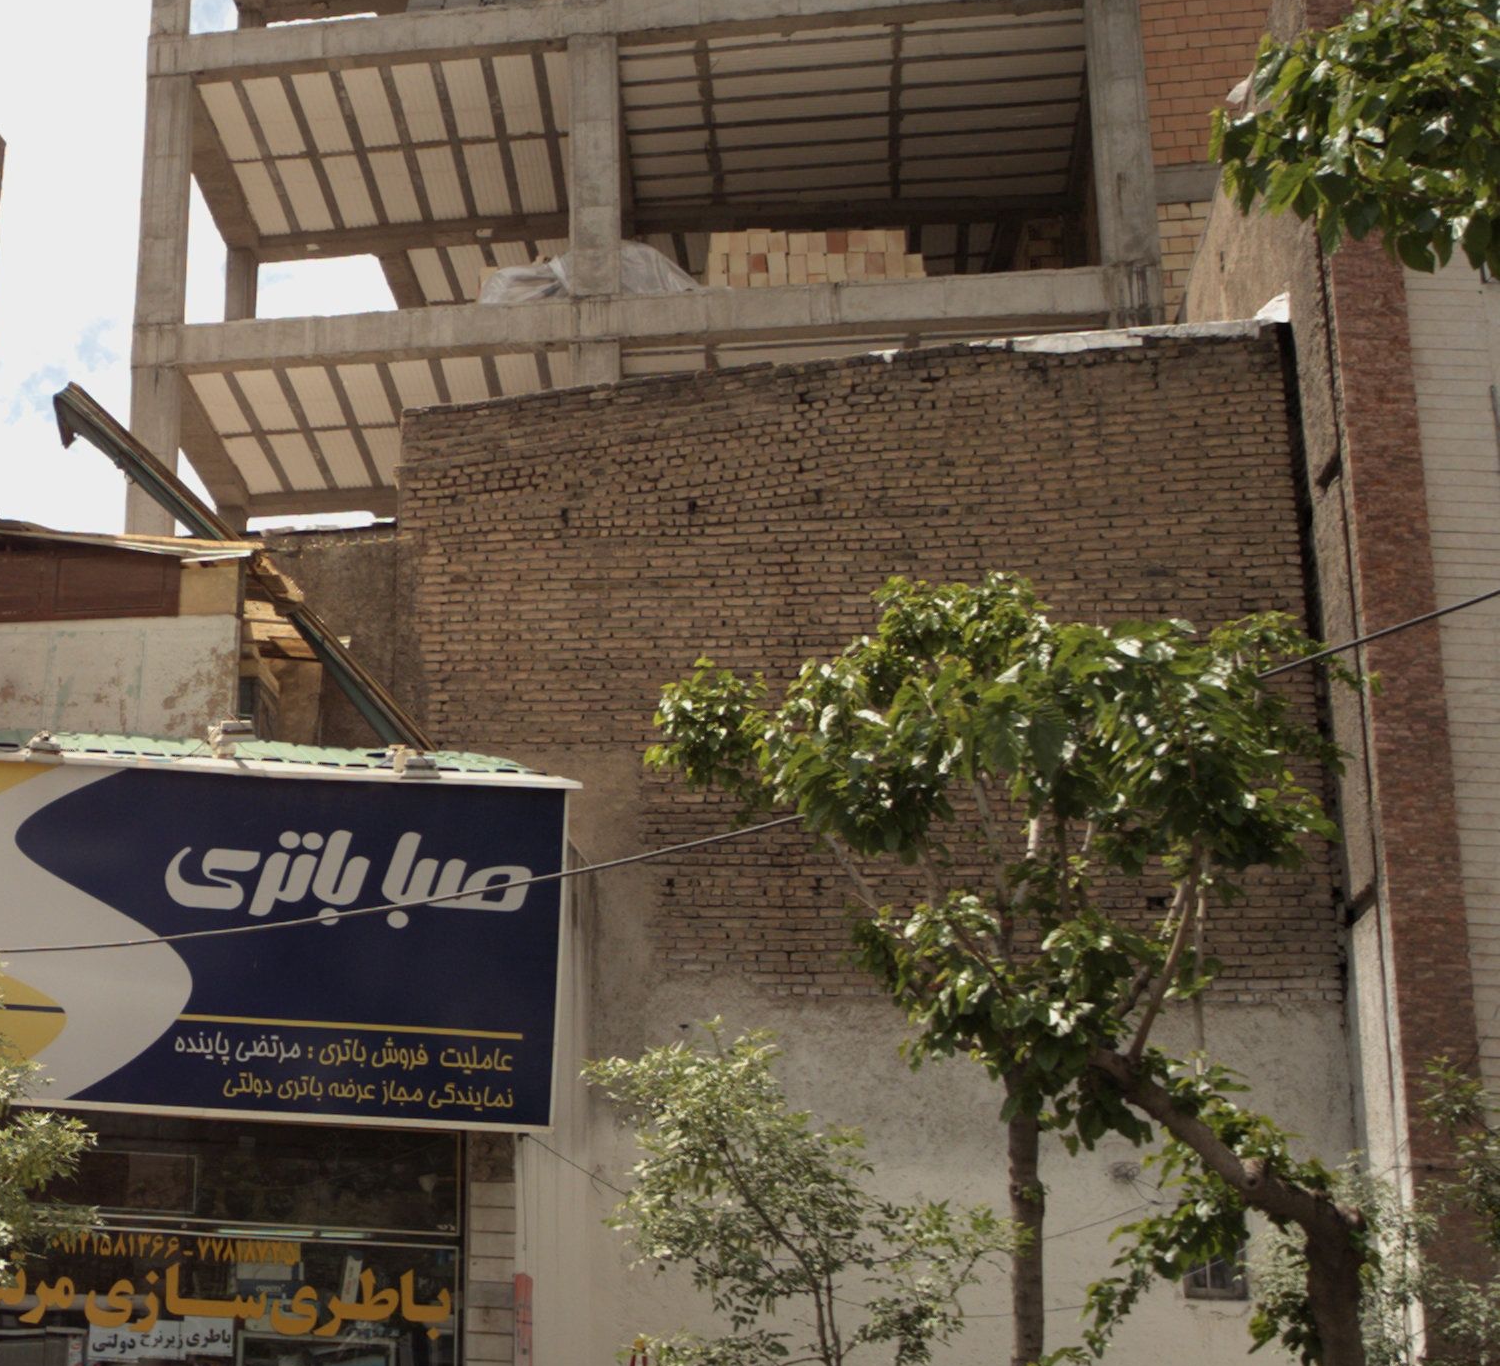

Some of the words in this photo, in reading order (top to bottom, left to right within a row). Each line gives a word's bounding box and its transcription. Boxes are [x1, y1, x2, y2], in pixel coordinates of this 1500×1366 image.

[164, 829, 371, 926] باتری
[382, 831, 532, 929] صبا
[174, 1031, 230, 1065] پاینده
[235, 1034, 301, 1063] مرتضی
[318, 1039, 367, 1068] باتری
[371, 1036, 430, 1070] فروش
[439, 1044, 514, 1074] عاملیت
[222, 1072, 273, 1098] دولتی
[277, 1075, 323, 1101] باتری
[328, 1078, 376, 1104] عرضه
[382, 1080, 423, 1105] مجاز
[427, 1082, 514, 1112] نمایندگی
[270, 1267, 452, 1341] باطری
